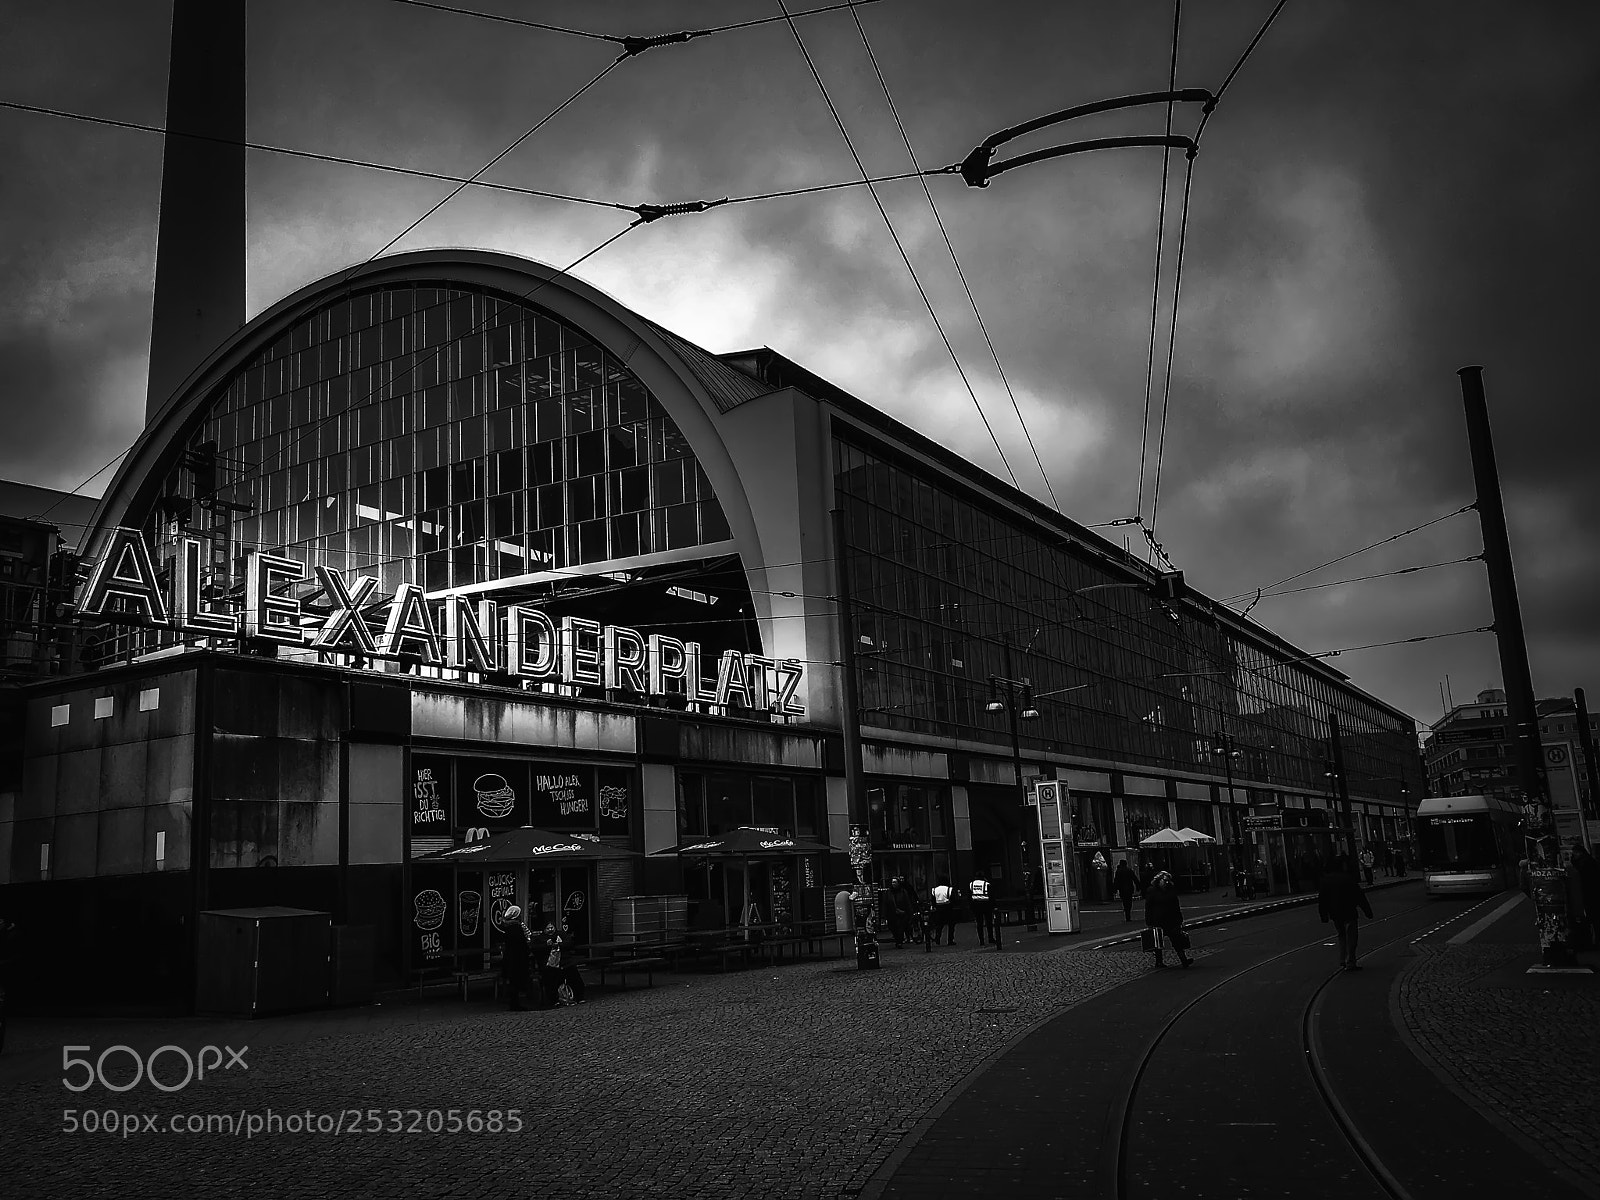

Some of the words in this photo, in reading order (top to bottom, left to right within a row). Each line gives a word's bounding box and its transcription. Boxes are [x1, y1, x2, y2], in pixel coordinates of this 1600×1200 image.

[75, 526, 806, 717] ALEXANDERPLATZ
[417, 768, 433, 782] HIER
[536, 774, 564, 792] HALLO
[419, 798, 429, 811] DU
[560, 798, 589, 815] HUNGER!
[1300, 817, 1308, 827] U
[497, 898, 508, 911] TO
